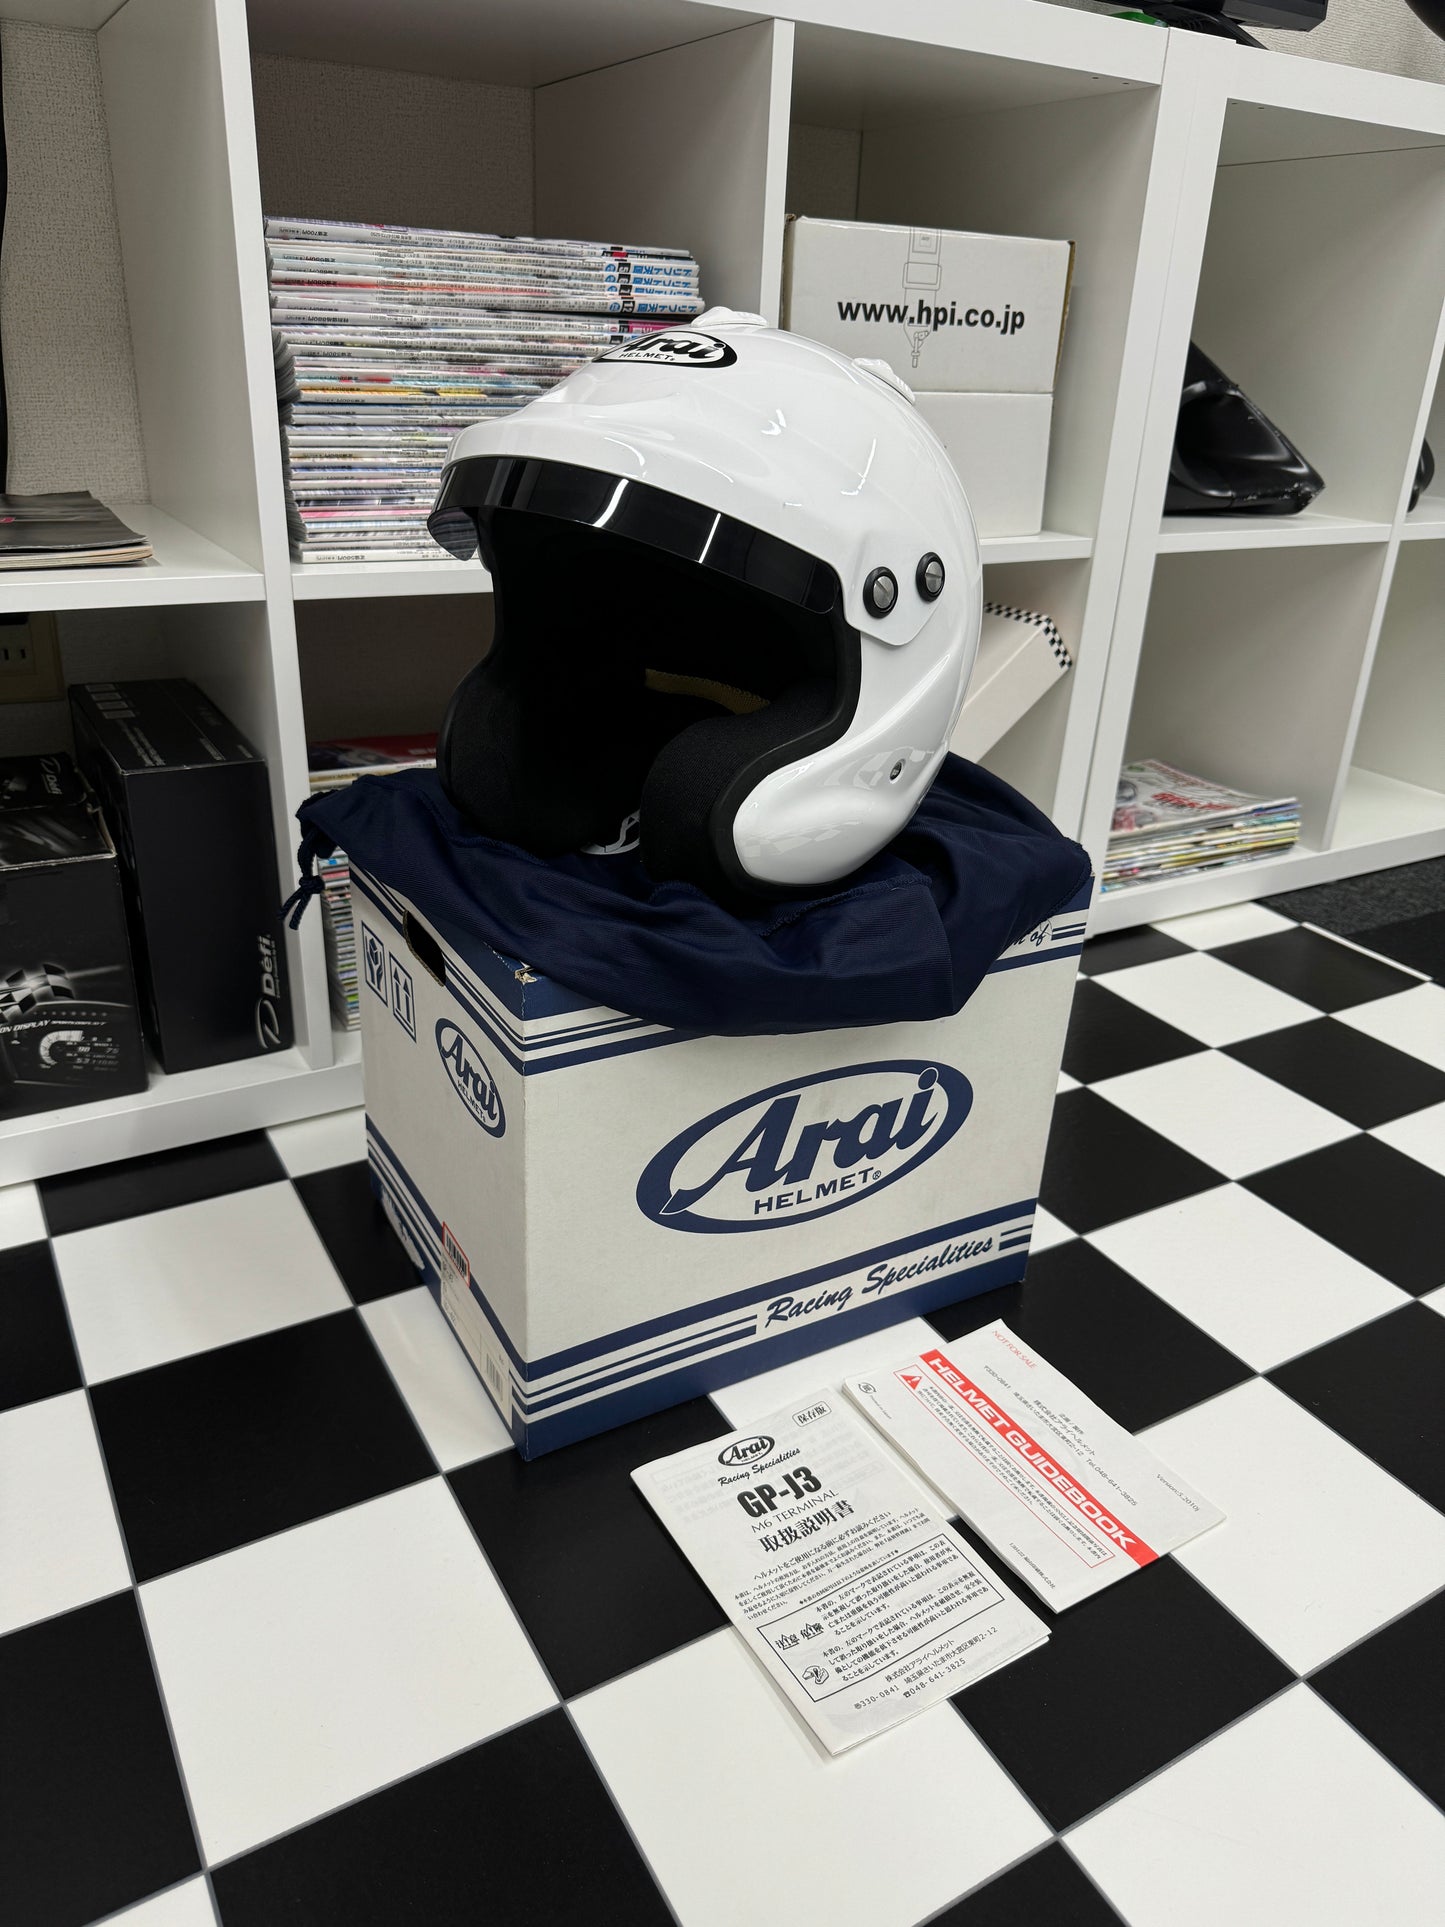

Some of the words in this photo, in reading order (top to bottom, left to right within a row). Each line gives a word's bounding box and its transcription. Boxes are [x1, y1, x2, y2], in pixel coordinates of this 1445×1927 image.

[837, 299, 1025, 335] www.hpi.co.jp
[440, 1034, 498, 1121] Arai
[659, 1067, 939, 1215] Arai
[763, 1285, 853, 1328] Racing
[861, 1236, 994, 1296] Specialities
[718, 1471, 750, 1486] Racing
[752, 1448, 801, 1474] Specialities
[723, 1437, 768, 1464] Arai
[927, 1357, 1011, 1431] HELMET
[1003, 1429, 1137, 1550] GUIDEBOOK
[737, 1466, 823, 1517] GP-J3
[751, 1519, 773, 1533] M6
[774, 1488, 839, 1521] TERMINAL
[752, 1509, 892, 1582] ヘルメットをご使用になる前に必ずお読みください
[758, 1499, 856, 1553] 取扱説明書
[884, 1637, 956, 1683] 株式会社アライヘルメット
